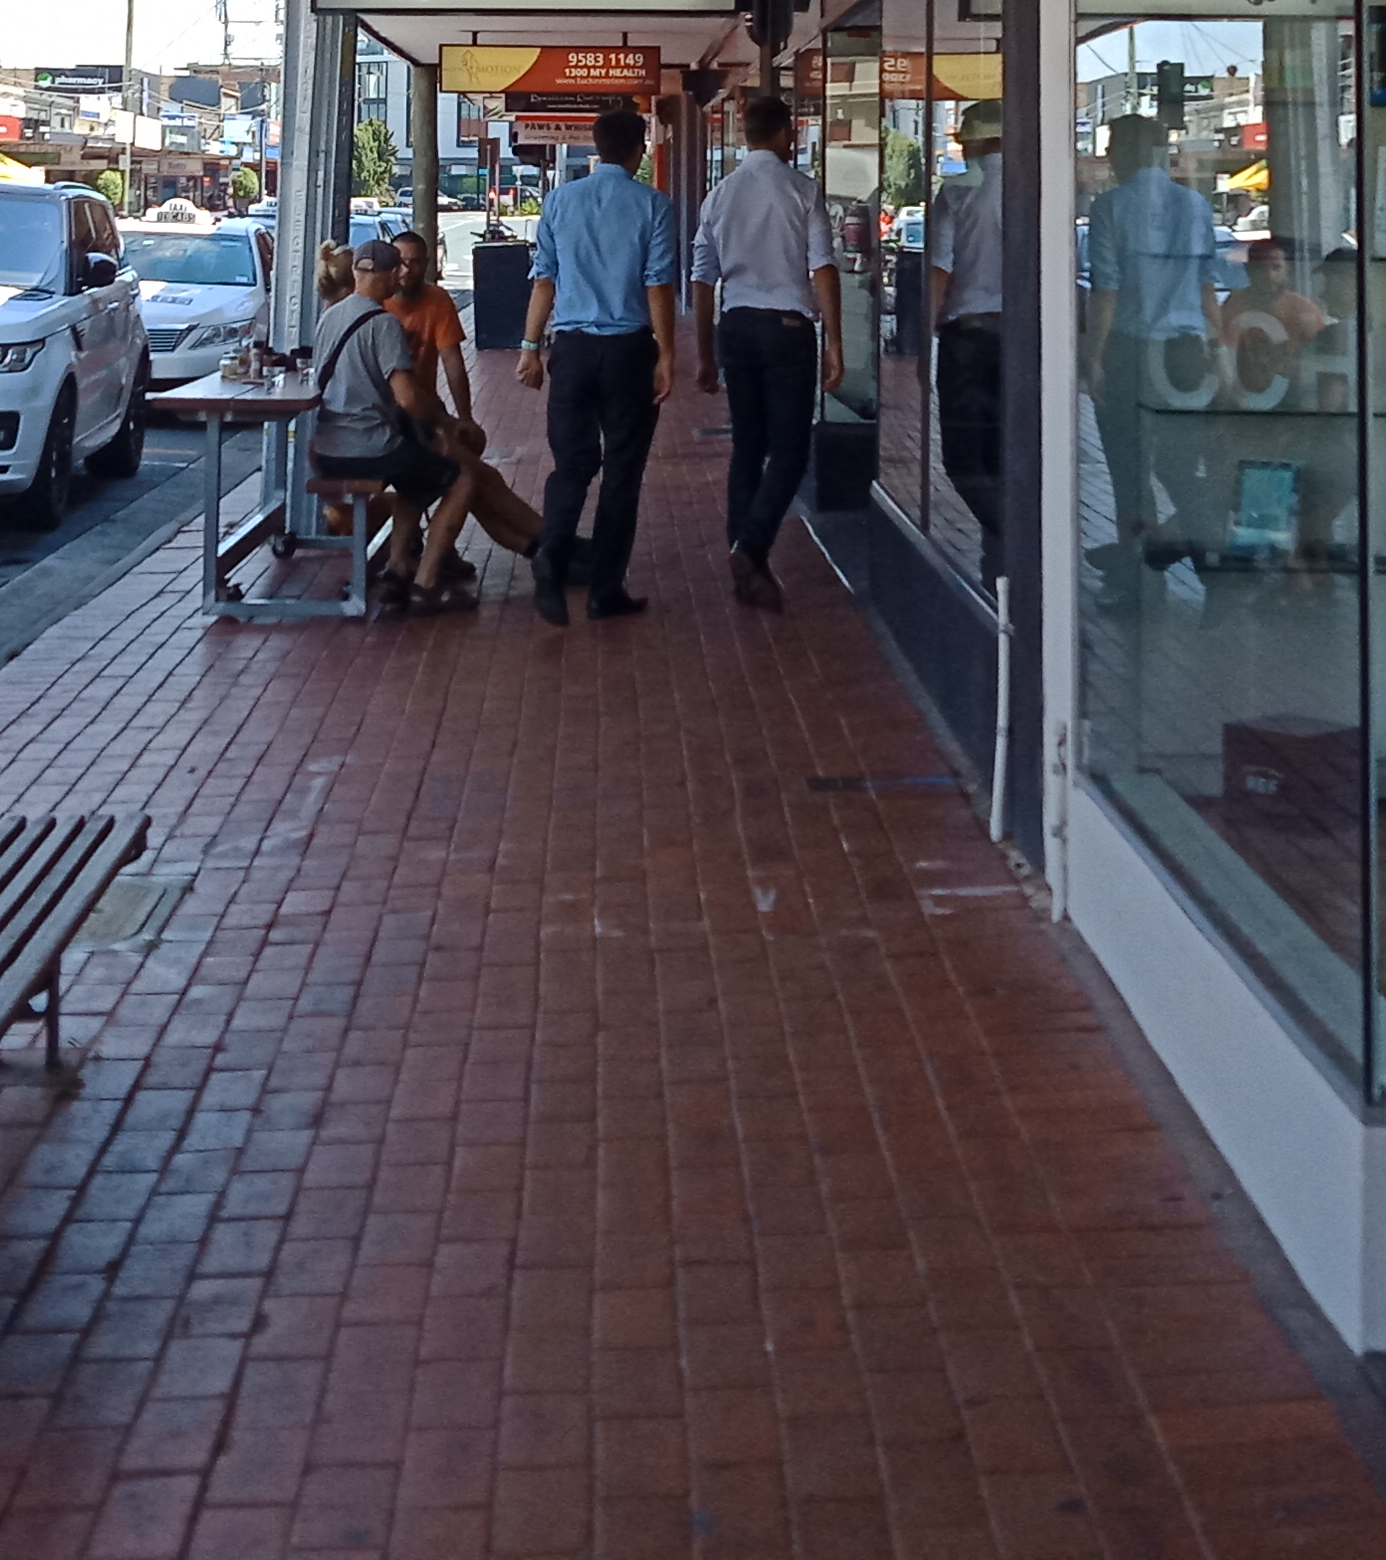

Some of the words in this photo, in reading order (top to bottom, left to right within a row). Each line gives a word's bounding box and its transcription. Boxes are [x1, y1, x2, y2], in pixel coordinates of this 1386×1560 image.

[568, 52, 604, 67] 9583
[609, 52, 644, 67] 1149
[564, 67, 587, 78] 1300
[590, 67, 606, 78] MY
[609, 67, 646, 78] HEALTH
[54, 75, 104, 87] pharmacy
